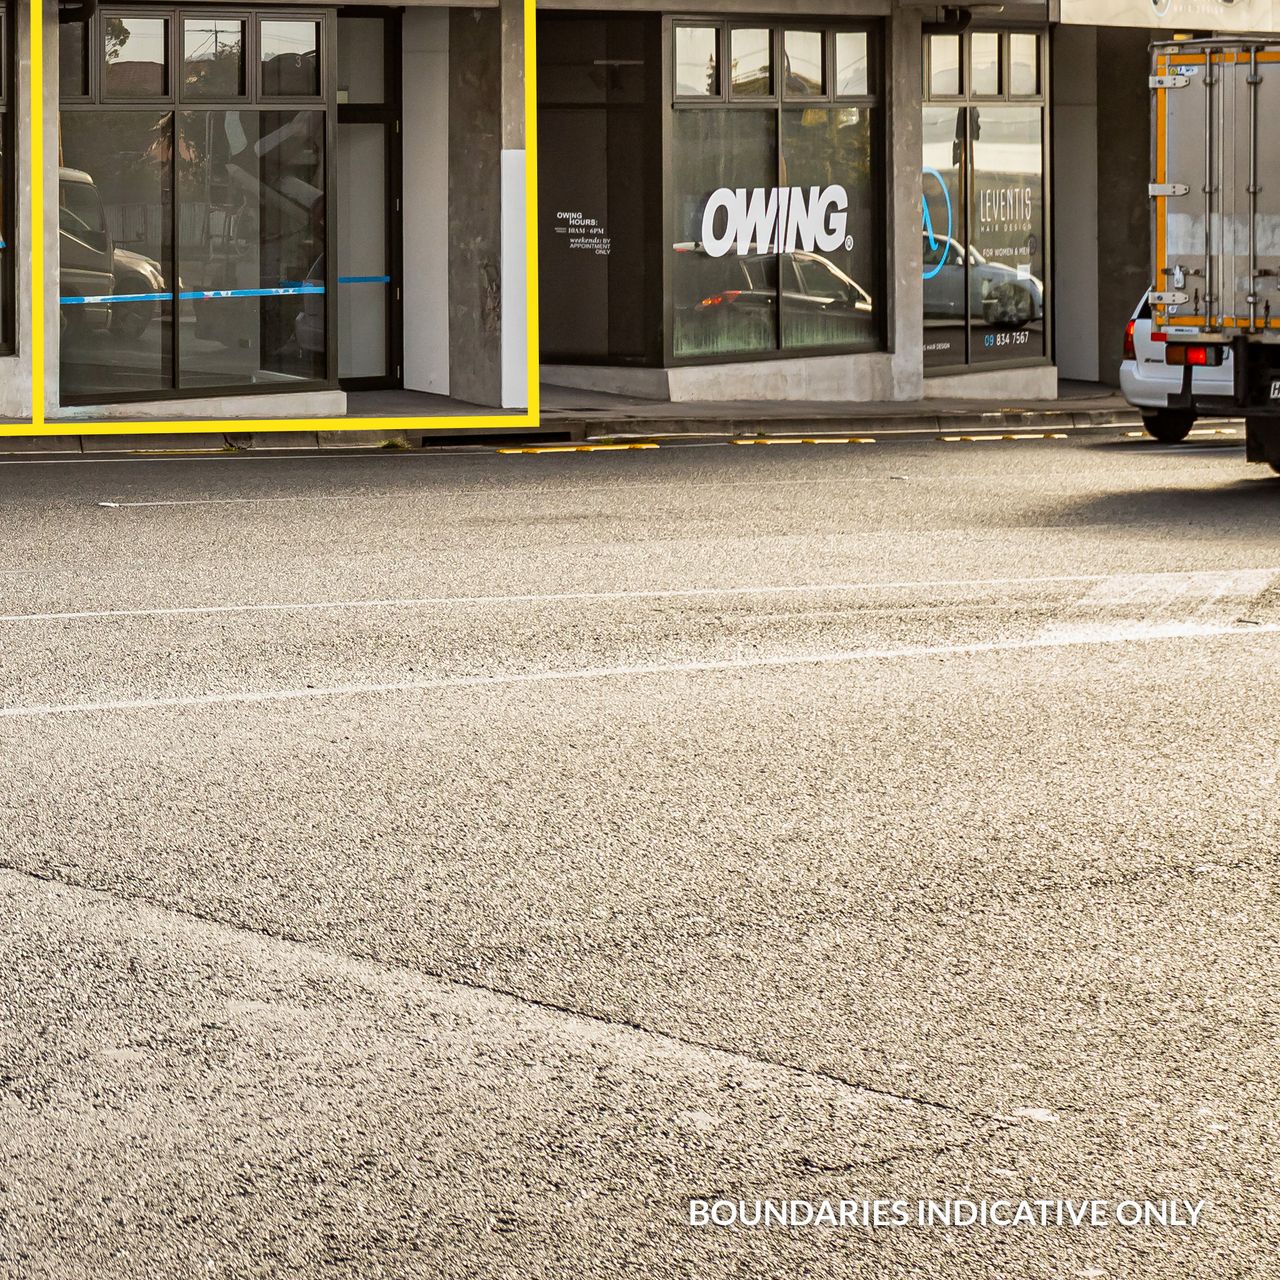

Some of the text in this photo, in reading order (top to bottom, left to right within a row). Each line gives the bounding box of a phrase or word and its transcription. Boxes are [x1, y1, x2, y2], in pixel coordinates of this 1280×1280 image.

[980, 187, 1032, 222] LEVENTIS
[1004, 223, 1032, 232] DESIGN
[982, 248, 993, 257] FOR
[994, 248, 1014, 257] WOMEN
[984, 334, 995, 346] 09
[996, 333, 1010, 346] 834
